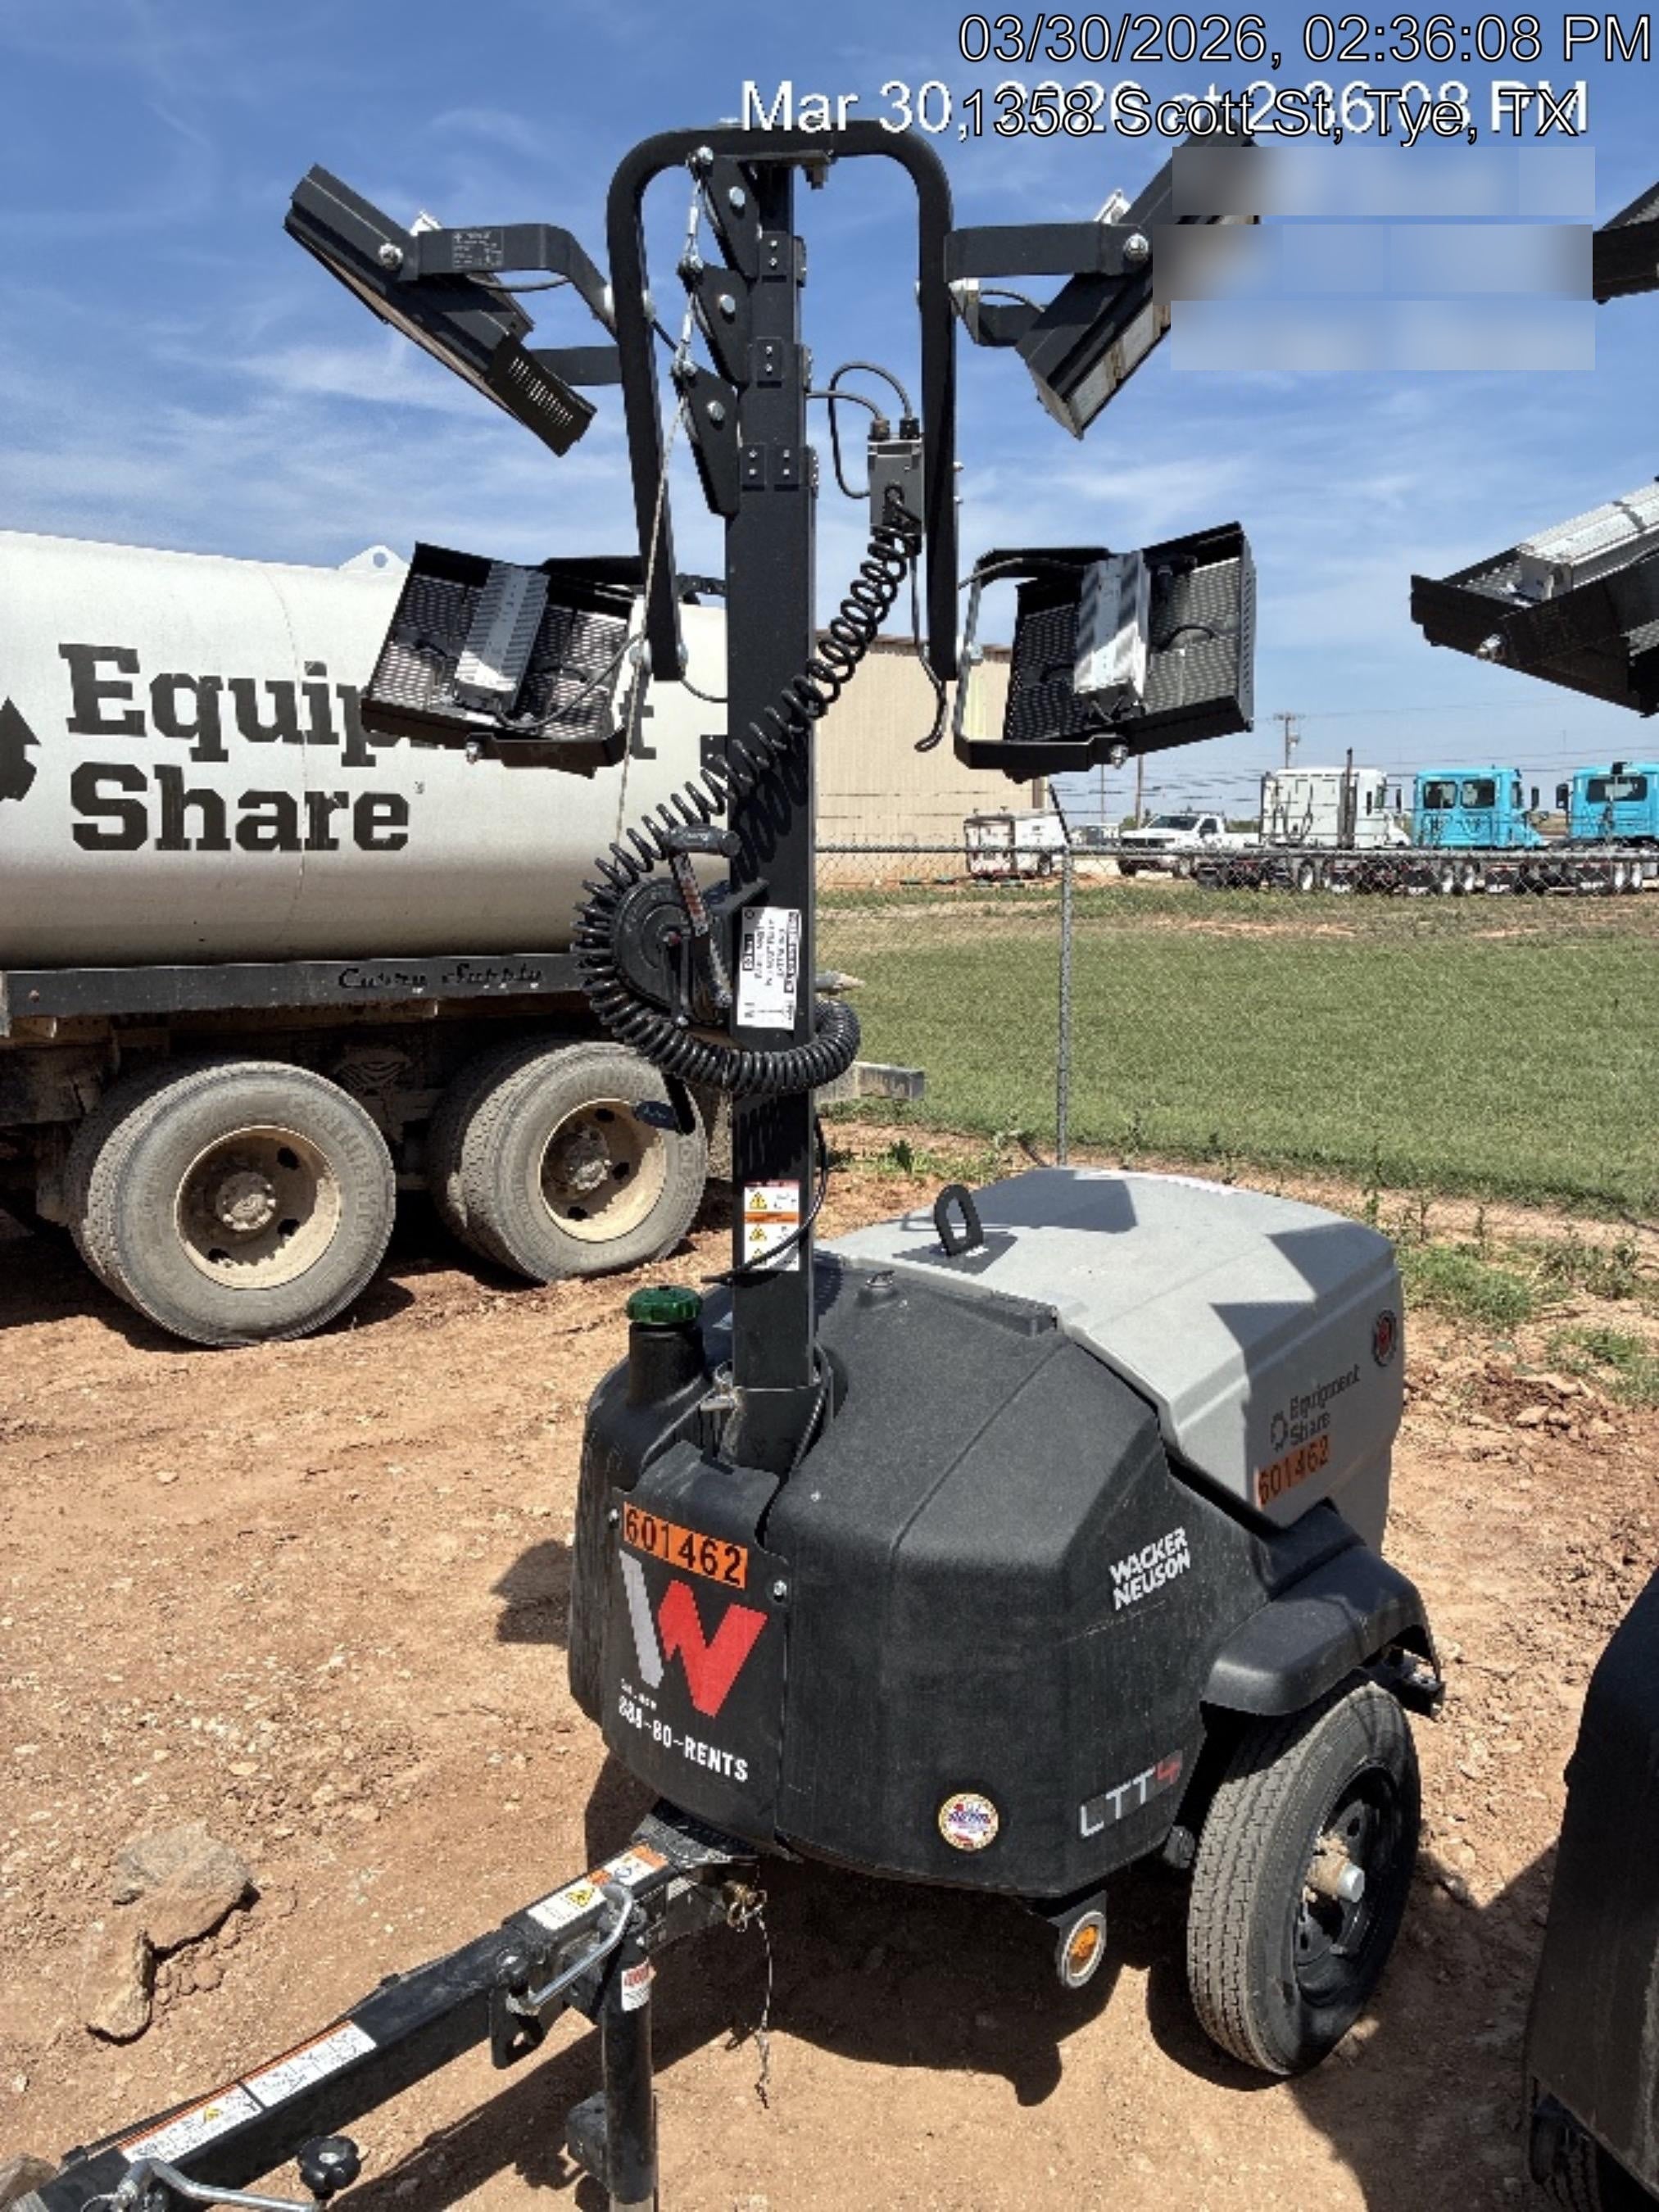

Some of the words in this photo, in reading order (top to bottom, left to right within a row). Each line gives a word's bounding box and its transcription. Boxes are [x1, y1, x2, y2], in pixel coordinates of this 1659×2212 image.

[70, 762, 410, 851] Share
[1290, 1363, 1360, 1421] Equipment
[1290, 1411, 1331, 1446] Share
[1258, 1435, 1329, 1506] 601462
[625, 1509, 741, 1585] 601462
[1109, 1526, 1188, 1585] WACKER
[1113, 1548, 1190, 1611] NEUSON
